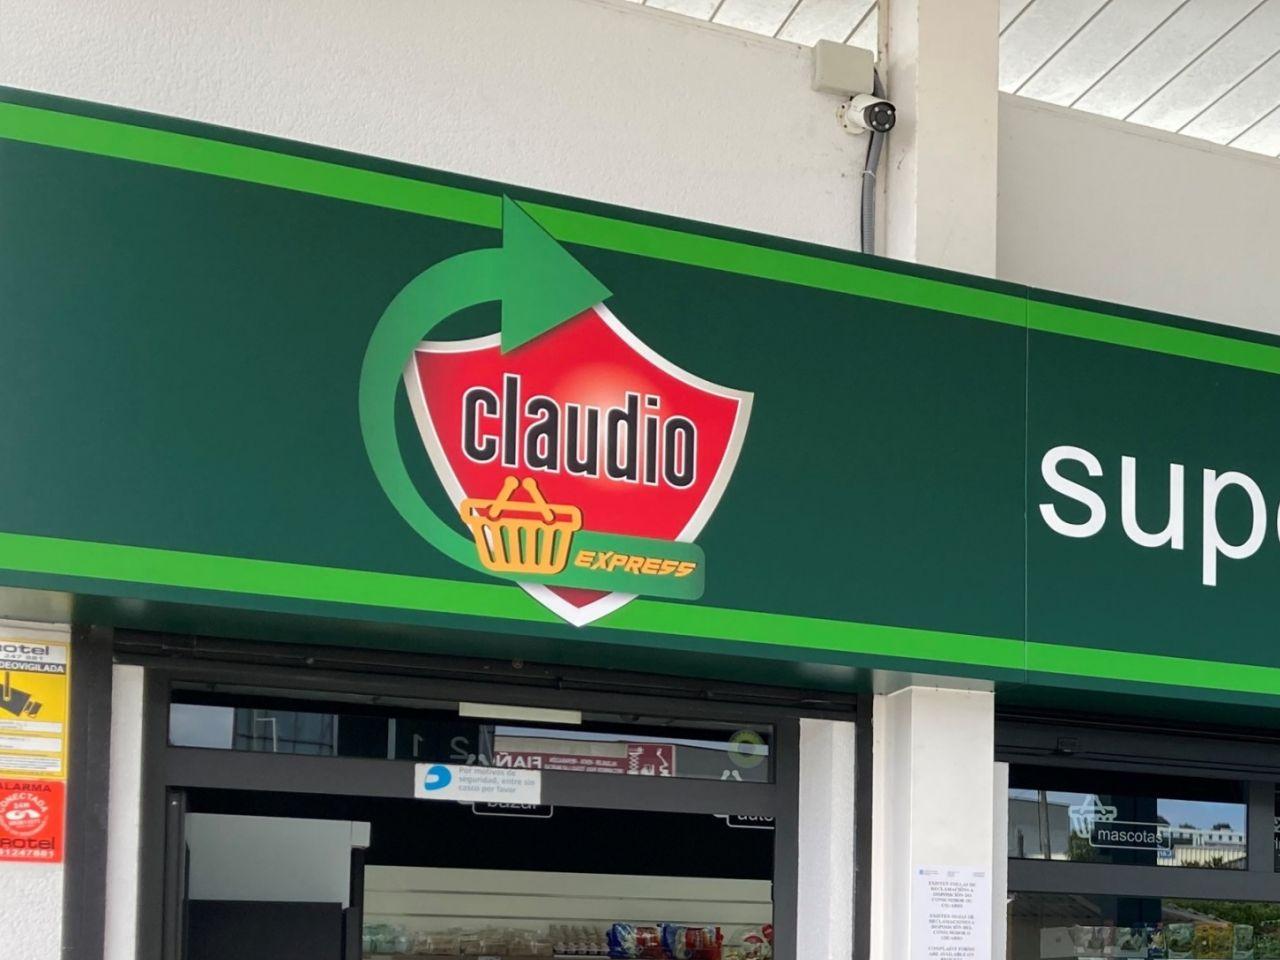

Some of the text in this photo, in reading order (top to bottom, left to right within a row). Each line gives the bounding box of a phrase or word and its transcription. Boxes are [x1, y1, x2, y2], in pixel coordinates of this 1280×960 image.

[461, 374, 698, 489] claudio
[574, 549, 698, 578] EXPRESS
[1098, 829, 1163, 844] mascotas
